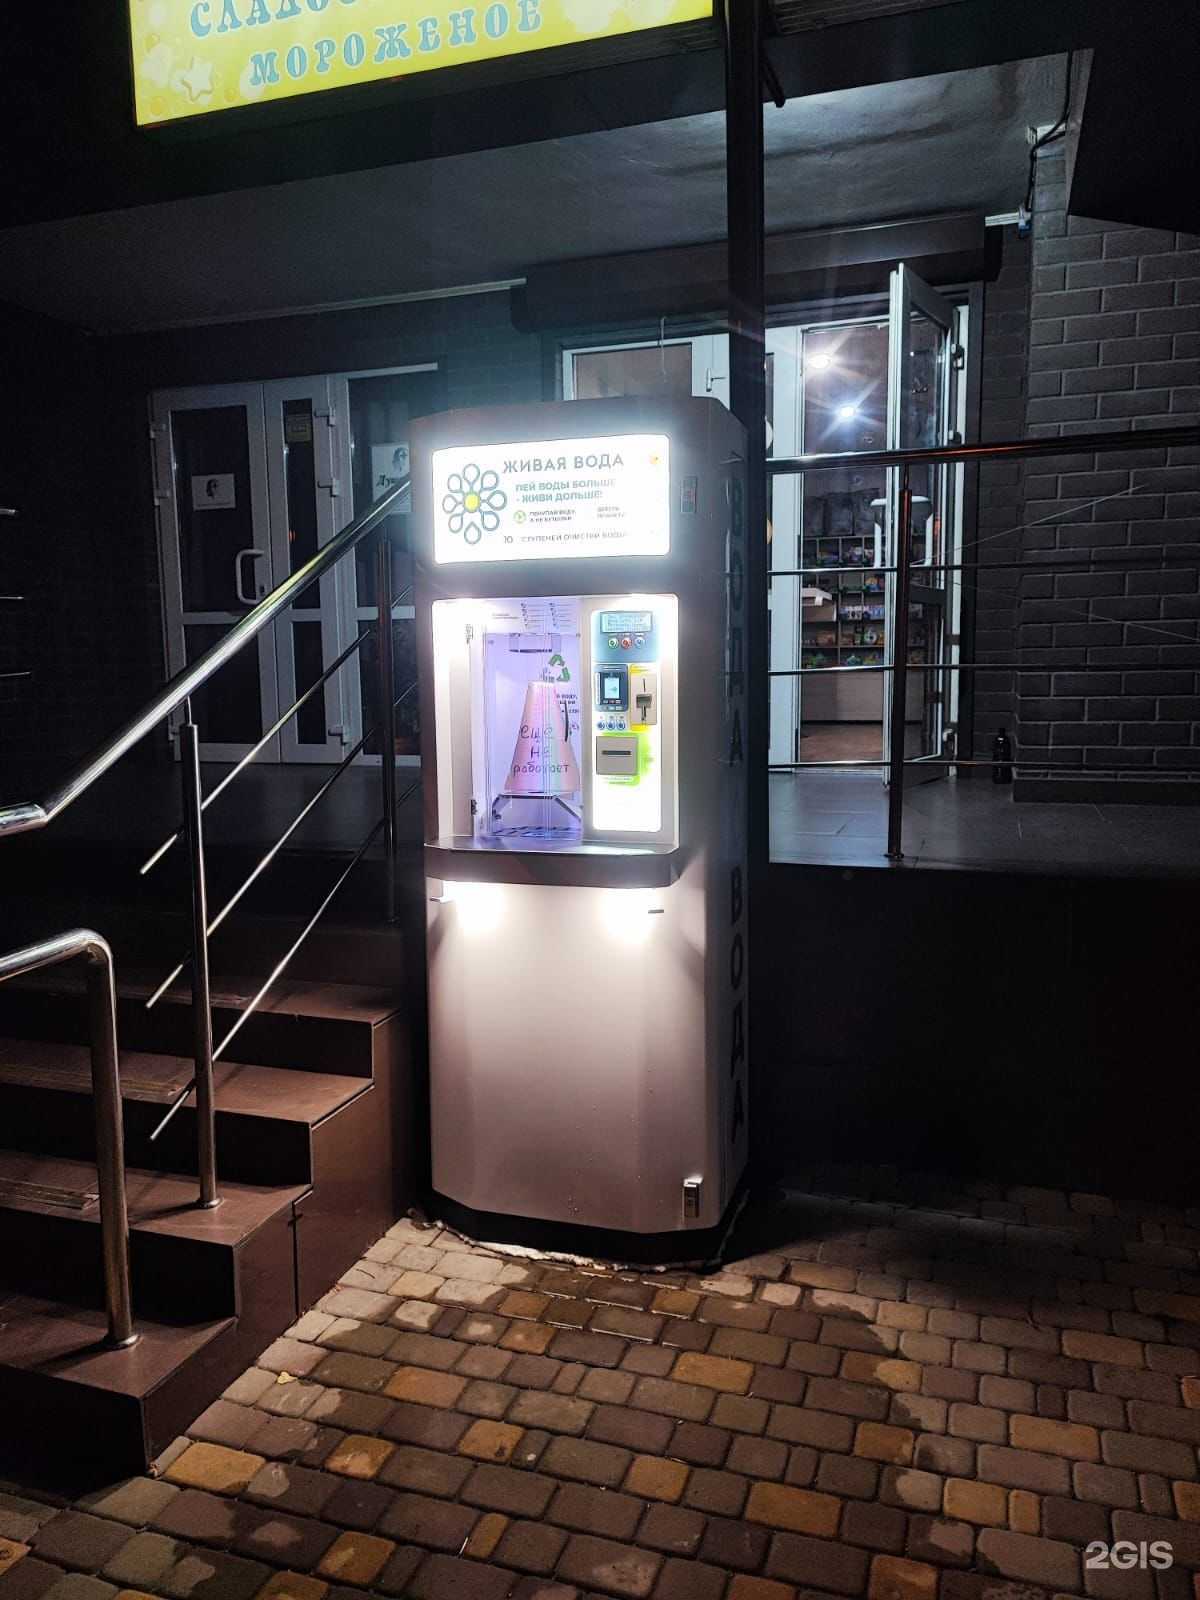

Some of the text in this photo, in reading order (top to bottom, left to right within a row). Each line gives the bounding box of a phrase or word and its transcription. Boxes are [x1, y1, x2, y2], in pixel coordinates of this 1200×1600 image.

[190, 0, 356, 37] СЛАД
[250, 0, 542, 86] МОРОЖЕНОЕ
[503, 453, 624, 473] ЖИВАЯ ВОДА
[515, 481, 536, 492] ПЕЙ
[538, 481, 570, 491] ВОДЫ
[522, 494, 553, 504] ЖИВИ
[504, 536, 514, 544] 10
[730, 866, 745, 1145] ВОДА
